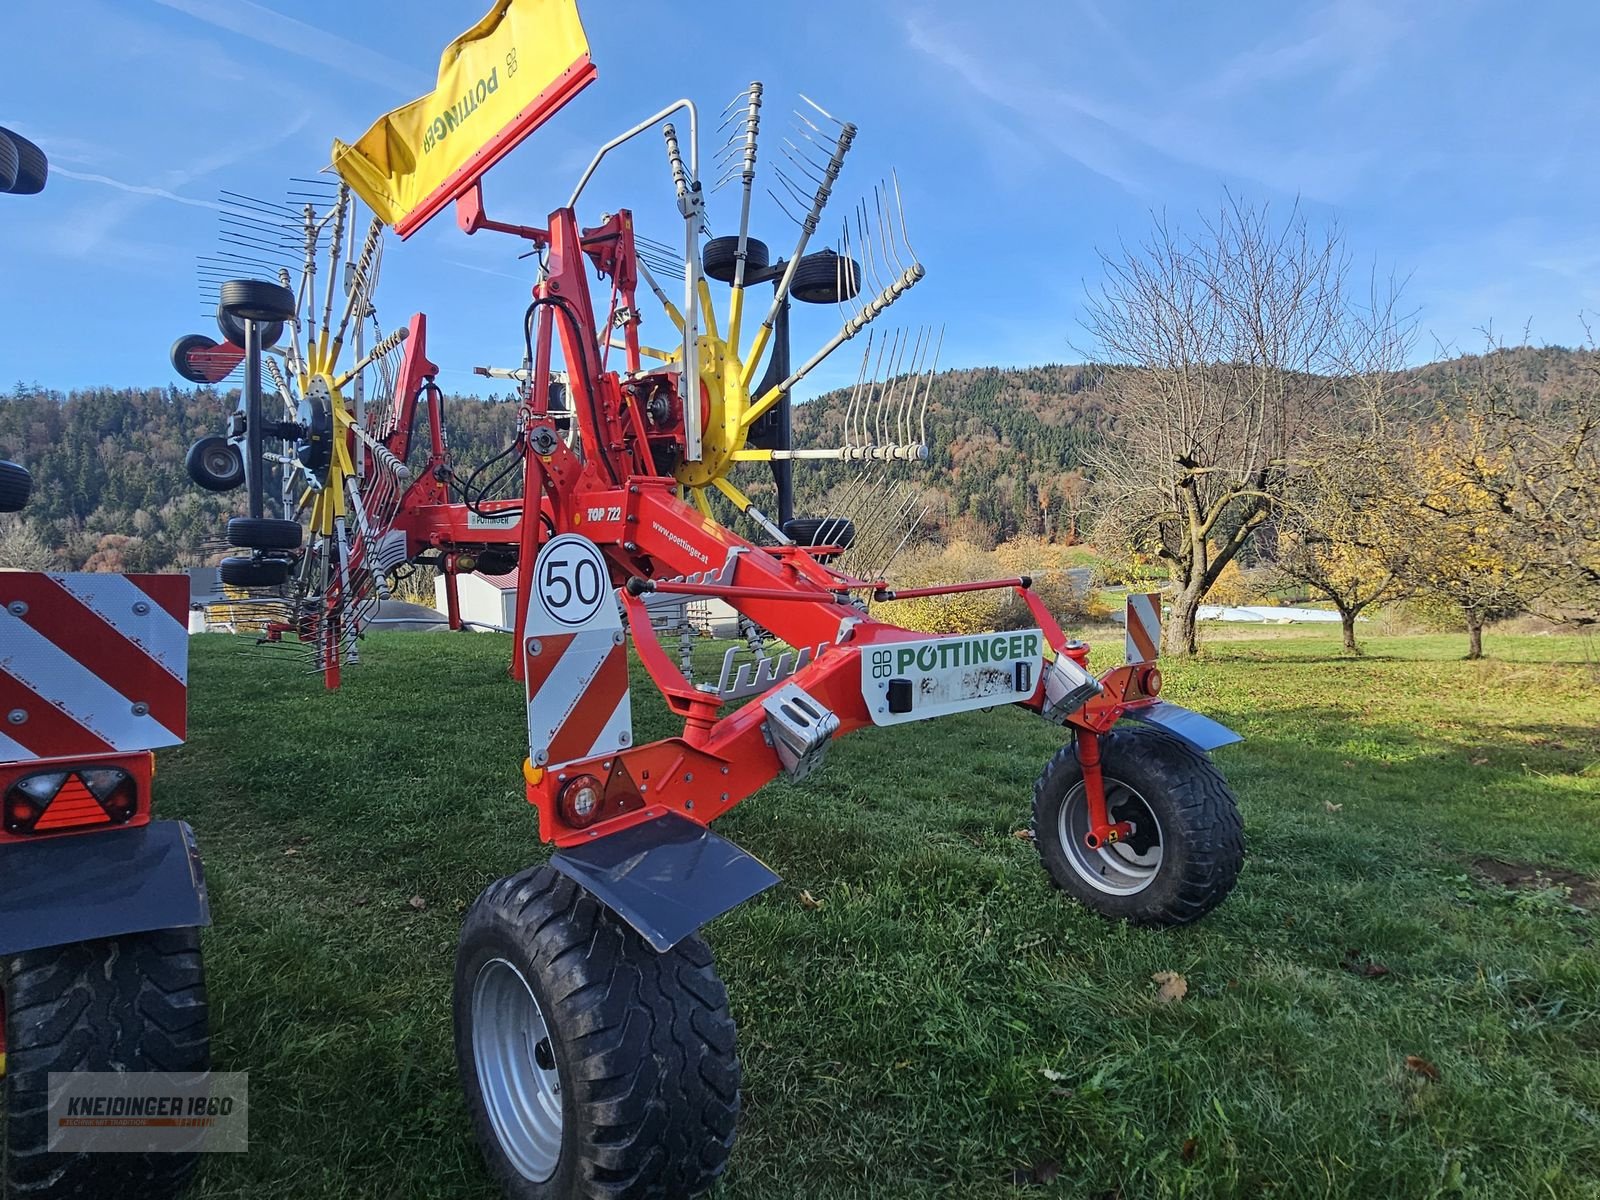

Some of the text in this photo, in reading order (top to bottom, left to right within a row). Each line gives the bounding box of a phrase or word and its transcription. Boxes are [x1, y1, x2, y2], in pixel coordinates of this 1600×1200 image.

[587, 507, 621, 521] TOP 722
[652, 521, 709, 564] www.poettinger.at
[546, 558, 600, 608] 50
[897, 634, 1038, 675] PÖTTINGER
